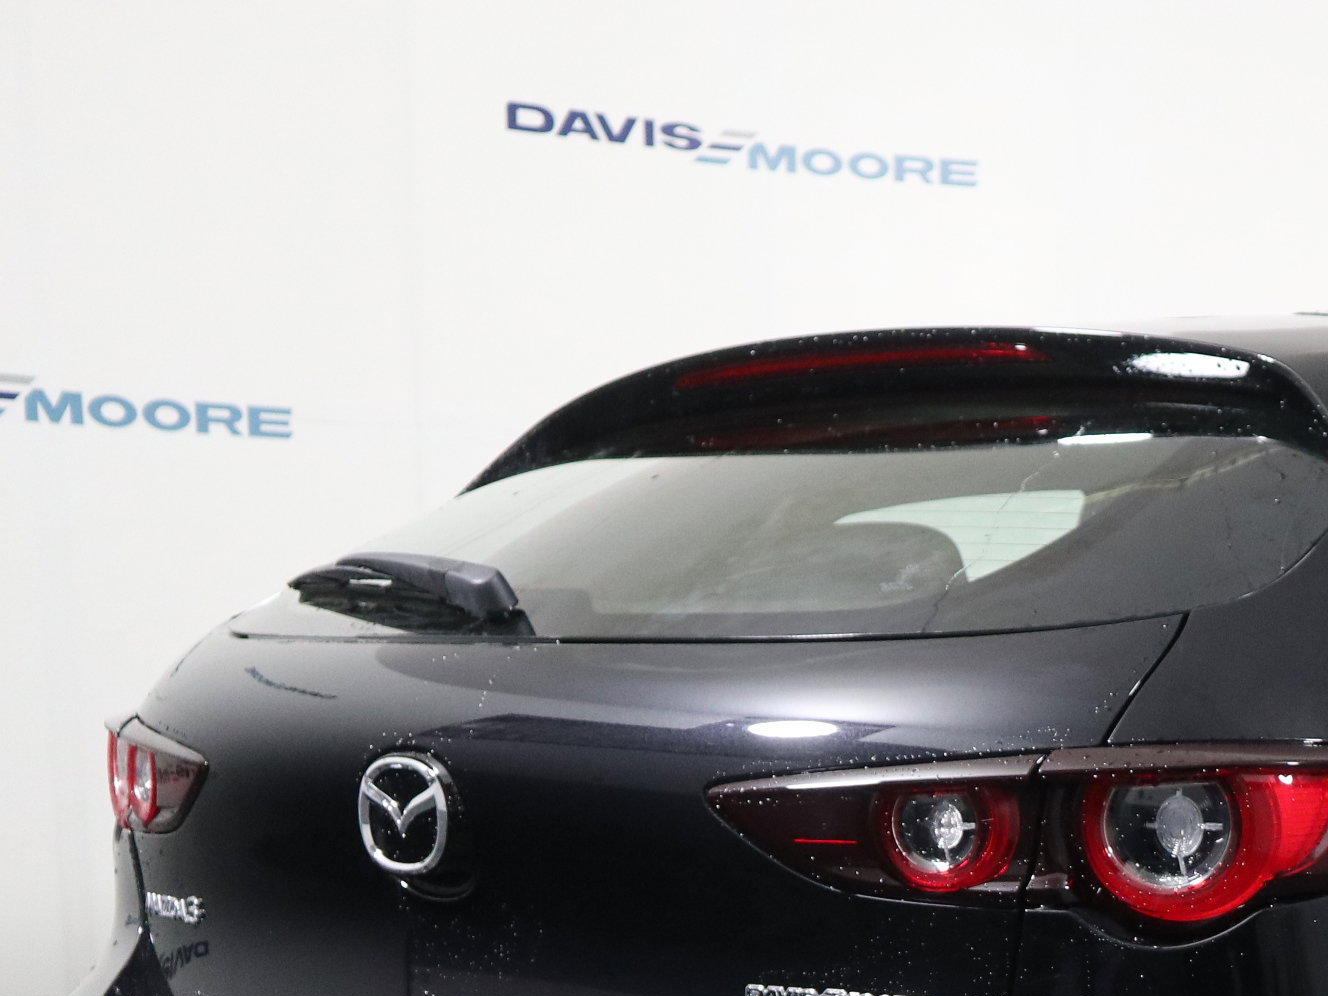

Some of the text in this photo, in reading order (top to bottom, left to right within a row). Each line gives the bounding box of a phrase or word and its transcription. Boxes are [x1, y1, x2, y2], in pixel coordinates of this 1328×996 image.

[506, 101, 979, 187] DAVIS MOORE
[24, 388, 292, 439] MOORE
